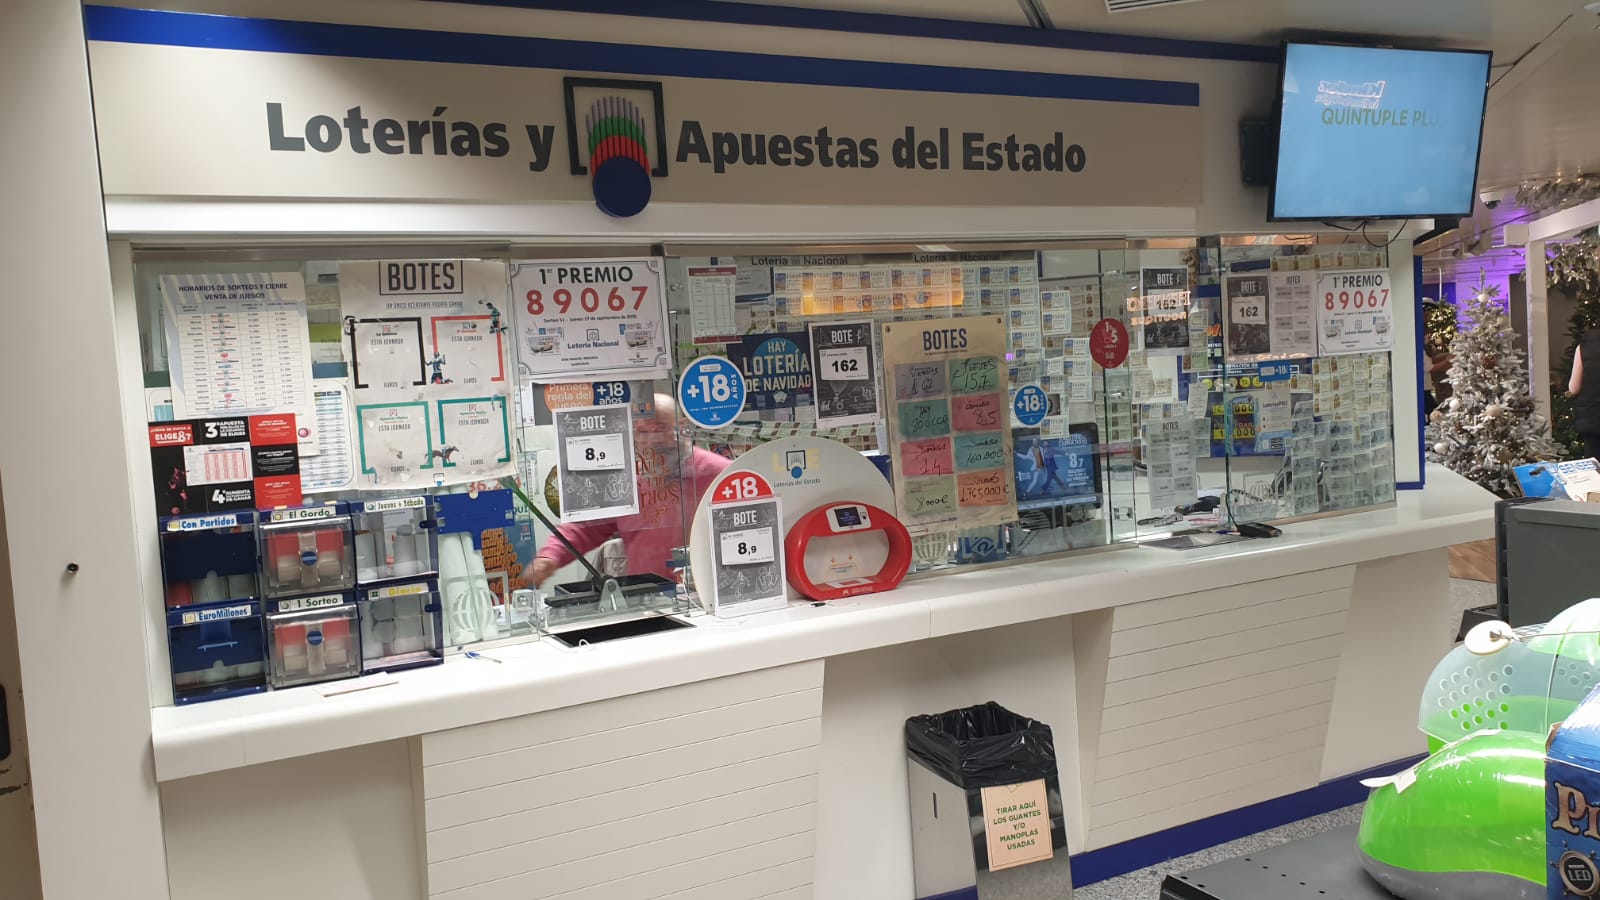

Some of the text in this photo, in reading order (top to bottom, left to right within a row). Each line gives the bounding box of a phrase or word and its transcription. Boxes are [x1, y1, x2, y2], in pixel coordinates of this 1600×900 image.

[1321, 107, 1409, 127] QUINTUPLE
[266, 102, 1087, 174] Loterías y Apuestas del Estado
[803, 256, 848, 265] Nacional
[387, 262, 455, 291] BOTES
[557, 265, 633, 284] PREMIO
[1157, 273, 1173, 285] BOTE
[1342, 274, 1383, 288] PREMIO
[179, 284, 216, 292] HORARIOS
[204, 293, 228, 301] VENTA
[239, 292, 266, 300] JUEGOS
[526, 285, 649, 316] 89067
[1325, 288, 1390, 311] 89067
[1239, 305, 1259, 318] 162
[831, 329, 854, 343] BOTE
[922, 327, 968, 351] BOTES
[592, 339, 620, 348] Nacional
[767, 340, 786, 353] HAY
[742, 348, 811, 377] LOTERÍA
[832, 358, 858, 373] 162
[549, 382, 625, 397] Primera +18
[687, 373, 731, 404] +18
[730, 373, 738, 400] AÑOS
[745, 374, 812, 393] DE NAVIDAD
[547, 391, 575, 401] regla
[576, 389, 591, 399] del
[1016, 394, 1041, 412] +18
[580, 414, 607, 430] BOTE
[1162, 421, 1179, 431] BOTES
[585, 447, 606, 462] 8,9
[721, 475, 759, 499] +18
[803, 477, 821, 485] Estado
[377, 501, 395, 511] Jueves
[403, 498, 424, 508] Sábado
[288, 508, 331, 519] El Gordo
[733, 510, 758, 526] BOTE
[181, 516, 236, 530] Con Partidos
[737, 542, 757, 556] 8,9
[388, 585, 422, 597] Diario
[296, 596, 338, 608] 1 Sorteo
[198, 608, 248, 621] EuroMillones
[995, 800, 1037, 814] TIRAR AQUÍ
[993, 809, 1041, 825] LOS GUANTES
[1012, 822, 1026, 831] Y/O
[999, 828, 1039, 843] MANOPLAS
[1006, 839, 1036, 851] USADAS
[1567, 868, 1592, 882] LED
